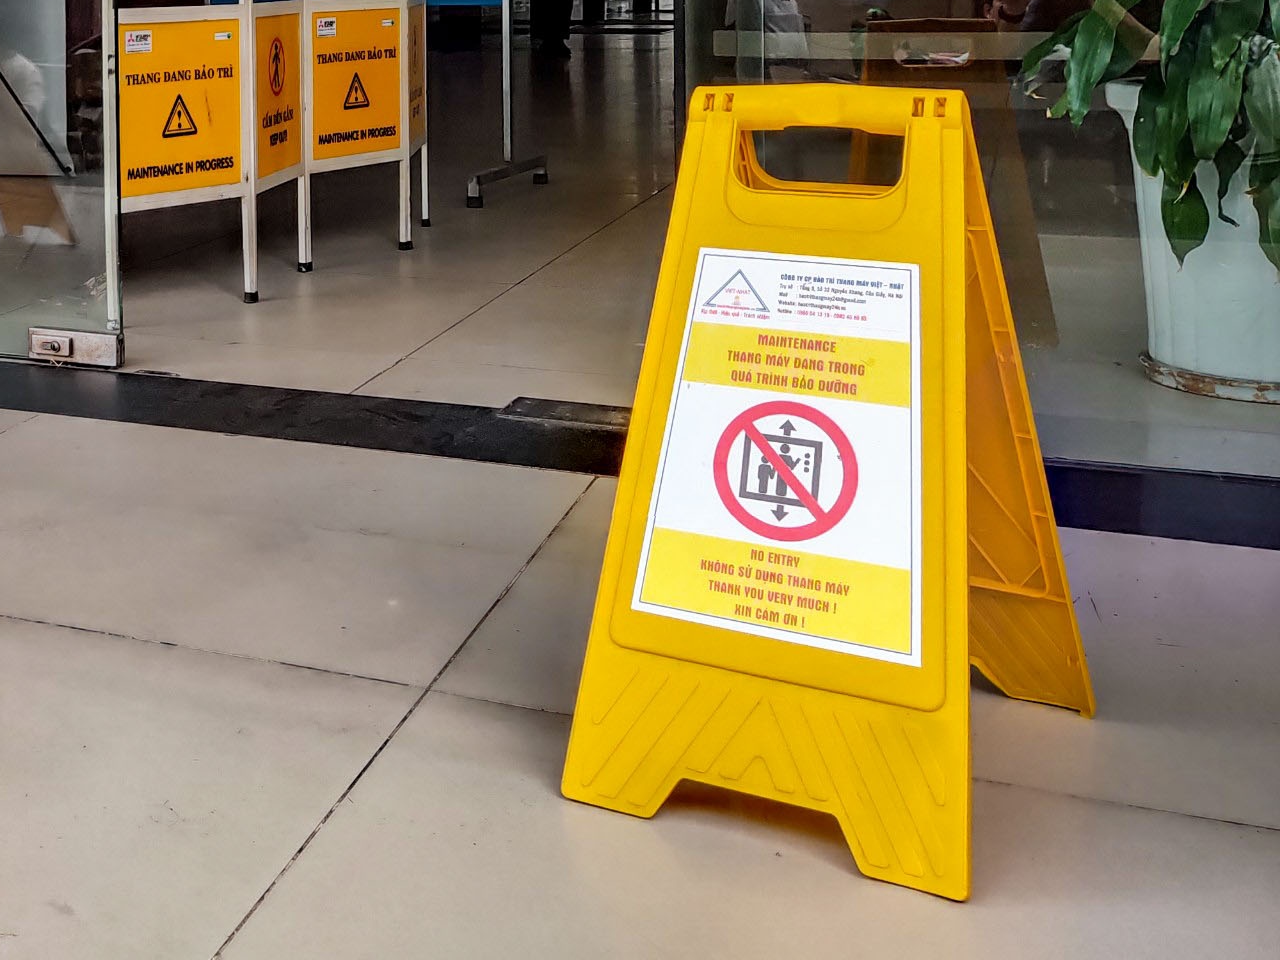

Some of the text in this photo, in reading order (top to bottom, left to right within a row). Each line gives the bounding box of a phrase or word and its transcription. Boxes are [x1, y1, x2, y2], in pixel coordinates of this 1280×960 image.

[316, 52, 343, 64] THANG
[367, 46, 382, 60] BẢO
[384, 46, 397, 59] TRÌ
[126, 72, 161, 86] THANG
[194, 64, 215, 80] BẢO
[217, 64, 234, 79] TRÌ
[318, 125, 397, 145] MAINTENANCE IN PROGRESS
[127, 156, 234, 180] MAINTENANCE IN PROGRESS
[758, 334, 837, 353] MAINTENANCE
[727, 350, 762, 364] THANG
[765, 353, 791, 367] MÁY
[828, 361, 866, 376] TRONG
[731, 368, 857, 395] QUÁ TRÌNH BẢO DƯỠNG
[750, 548, 800, 568] NO ENTRY
[700, 559, 850, 596] KHÔNG SỬ DỤNG THANG MÁY
[708, 579, 830, 613] THANK YOU VERY MUCH
[734, 603, 752, 618] XIN
[783, 613, 798, 627] ƠN
